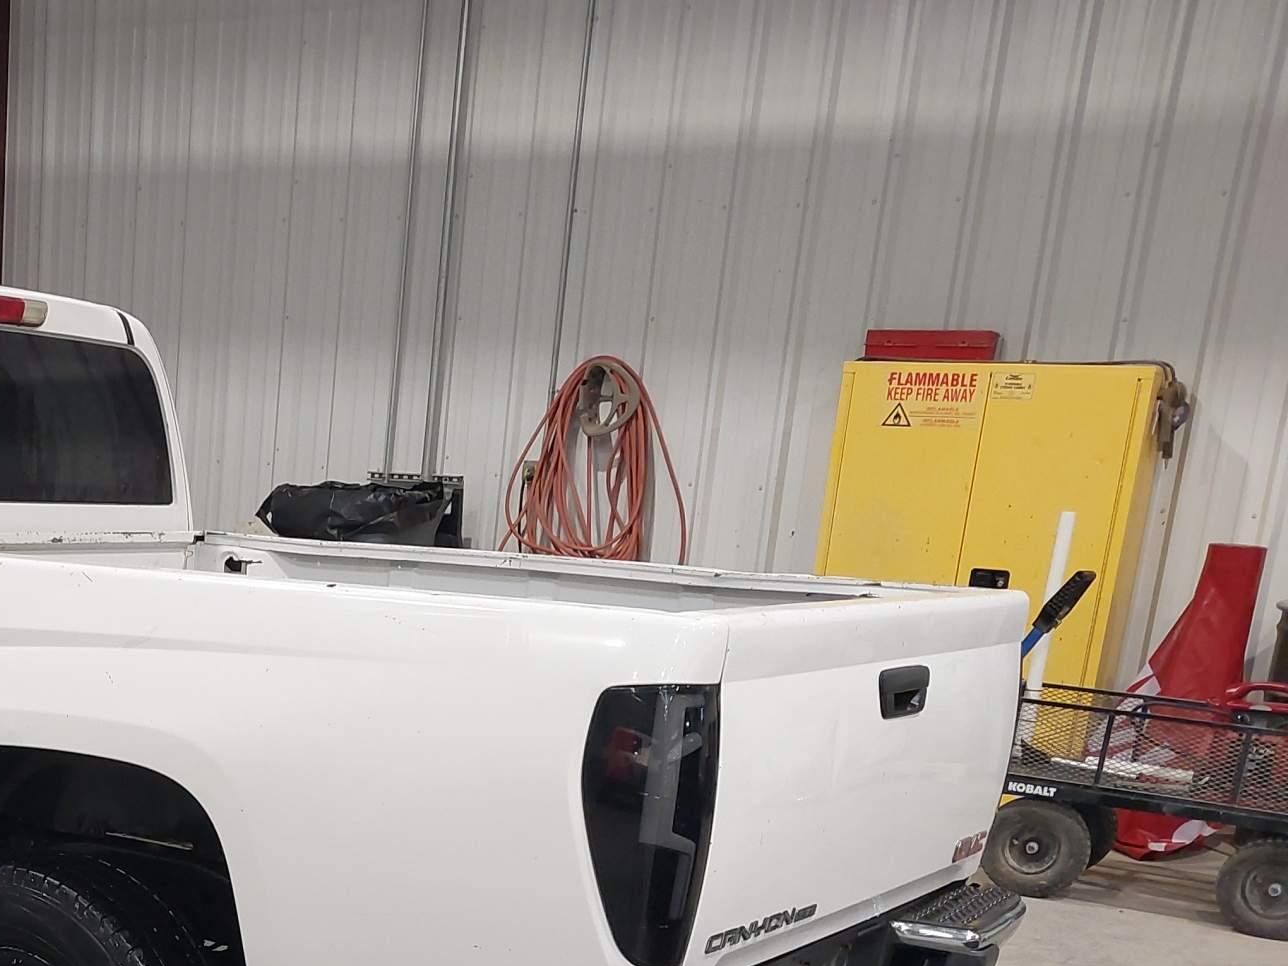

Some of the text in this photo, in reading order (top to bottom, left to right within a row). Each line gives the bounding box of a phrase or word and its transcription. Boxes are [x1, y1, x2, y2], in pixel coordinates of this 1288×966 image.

[888, 372, 978, 388] FLAMMABLE
[887, 387, 976, 403] KEEP FIRE AWAY
[1008, 782, 1057, 797] KOBALT
